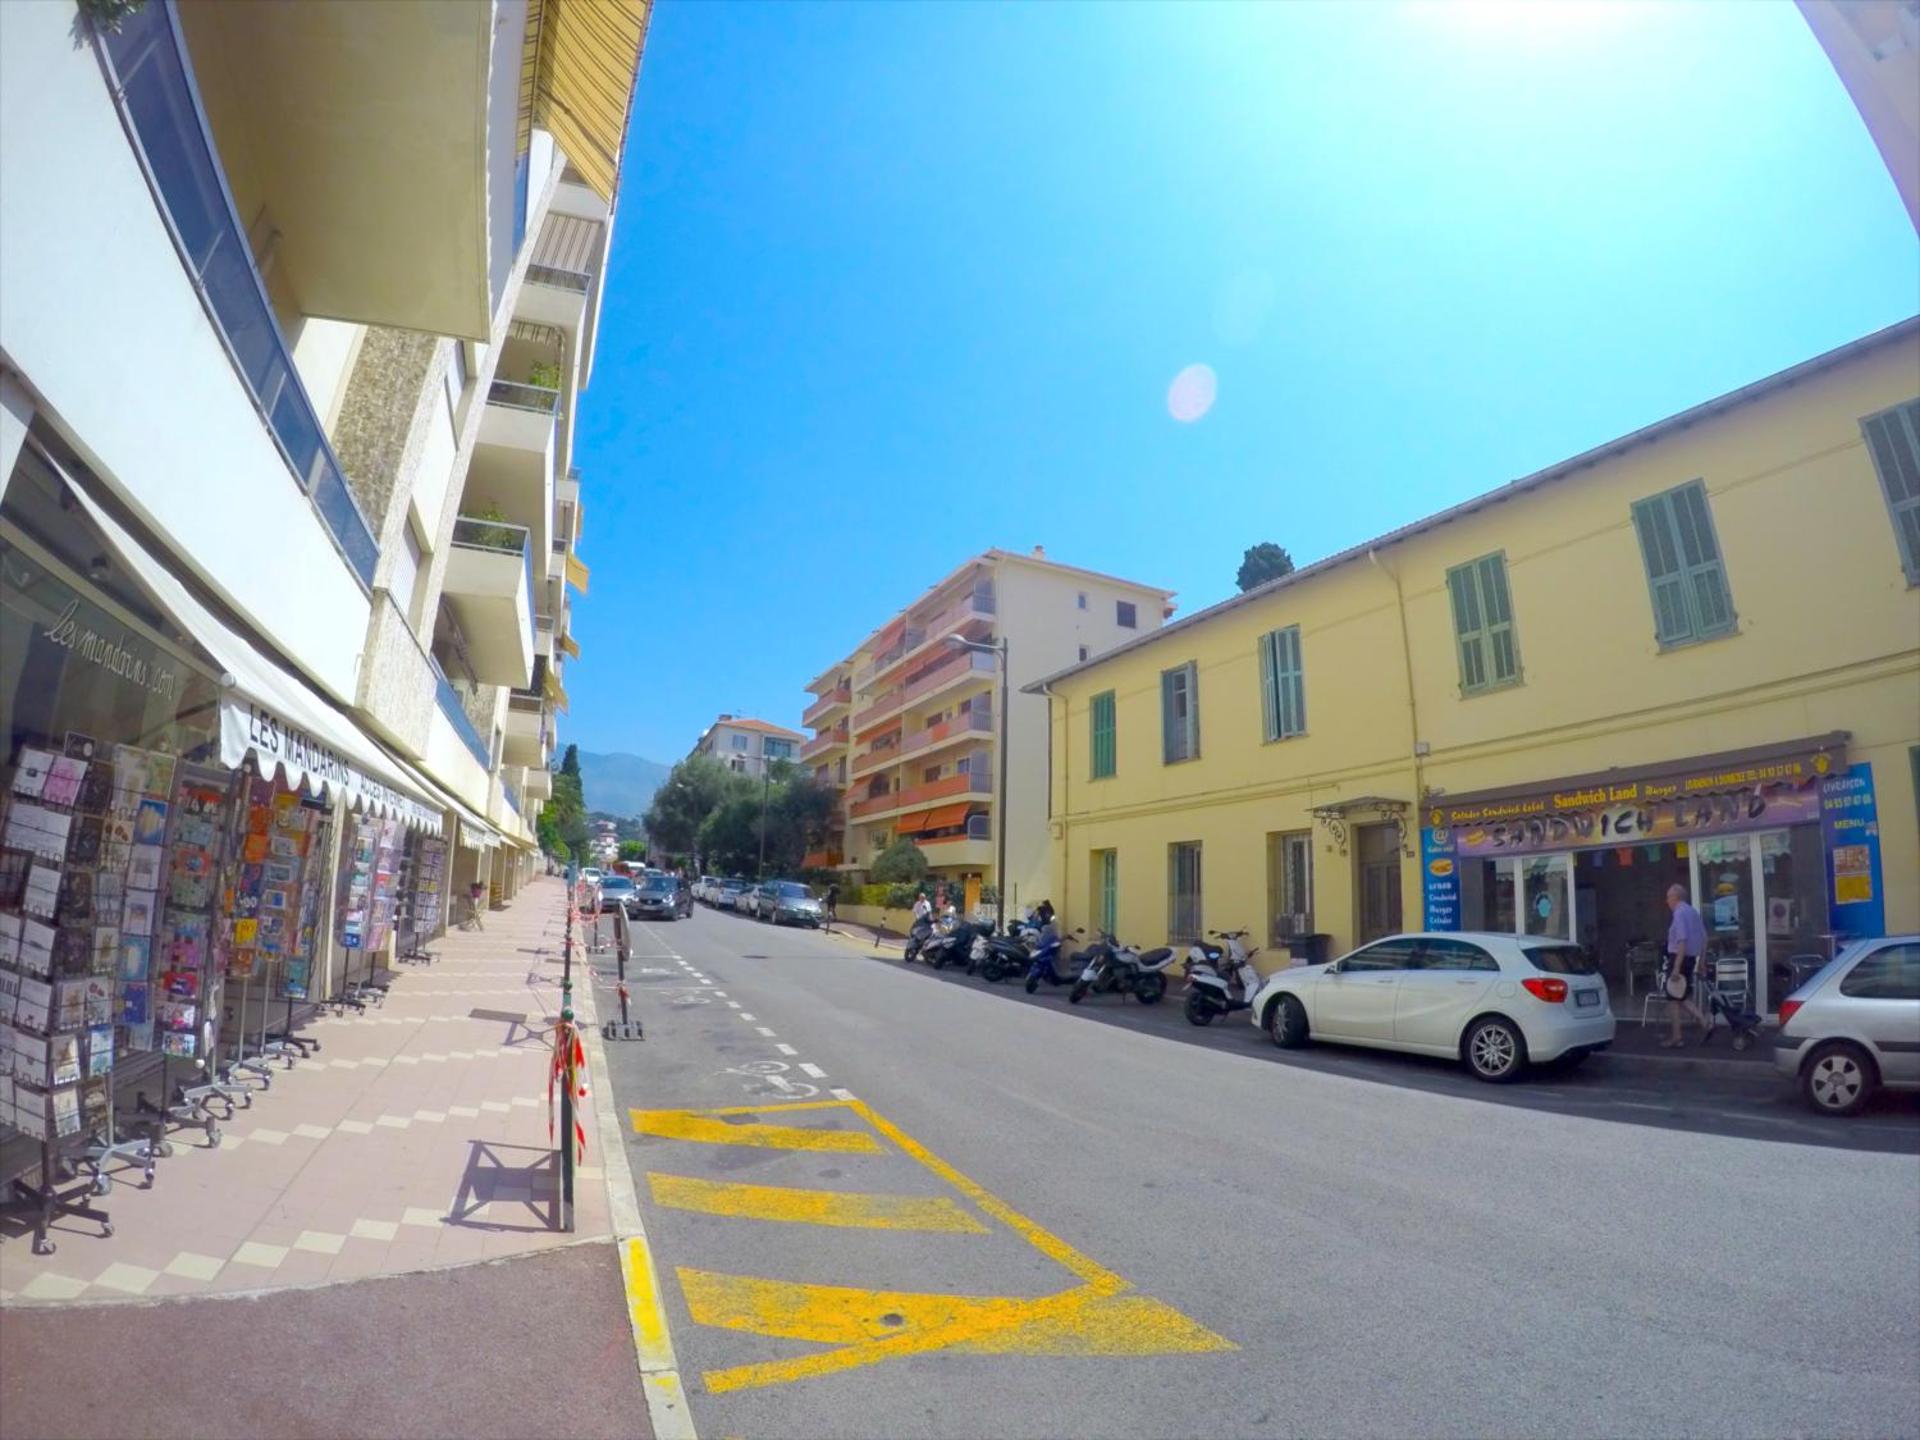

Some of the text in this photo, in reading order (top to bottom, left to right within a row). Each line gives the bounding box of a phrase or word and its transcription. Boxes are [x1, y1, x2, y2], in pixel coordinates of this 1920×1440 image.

[250, 704, 279, 754] LES
[284, 726, 350, 787] MANDARINS
[1492, 783, 1766, 848] SANDWICH LAND
[1553, 787, 1607, 809] Sandwich
[1609, 784, 1637, 801] Land
[1834, 817, 1865, 830] MENU
